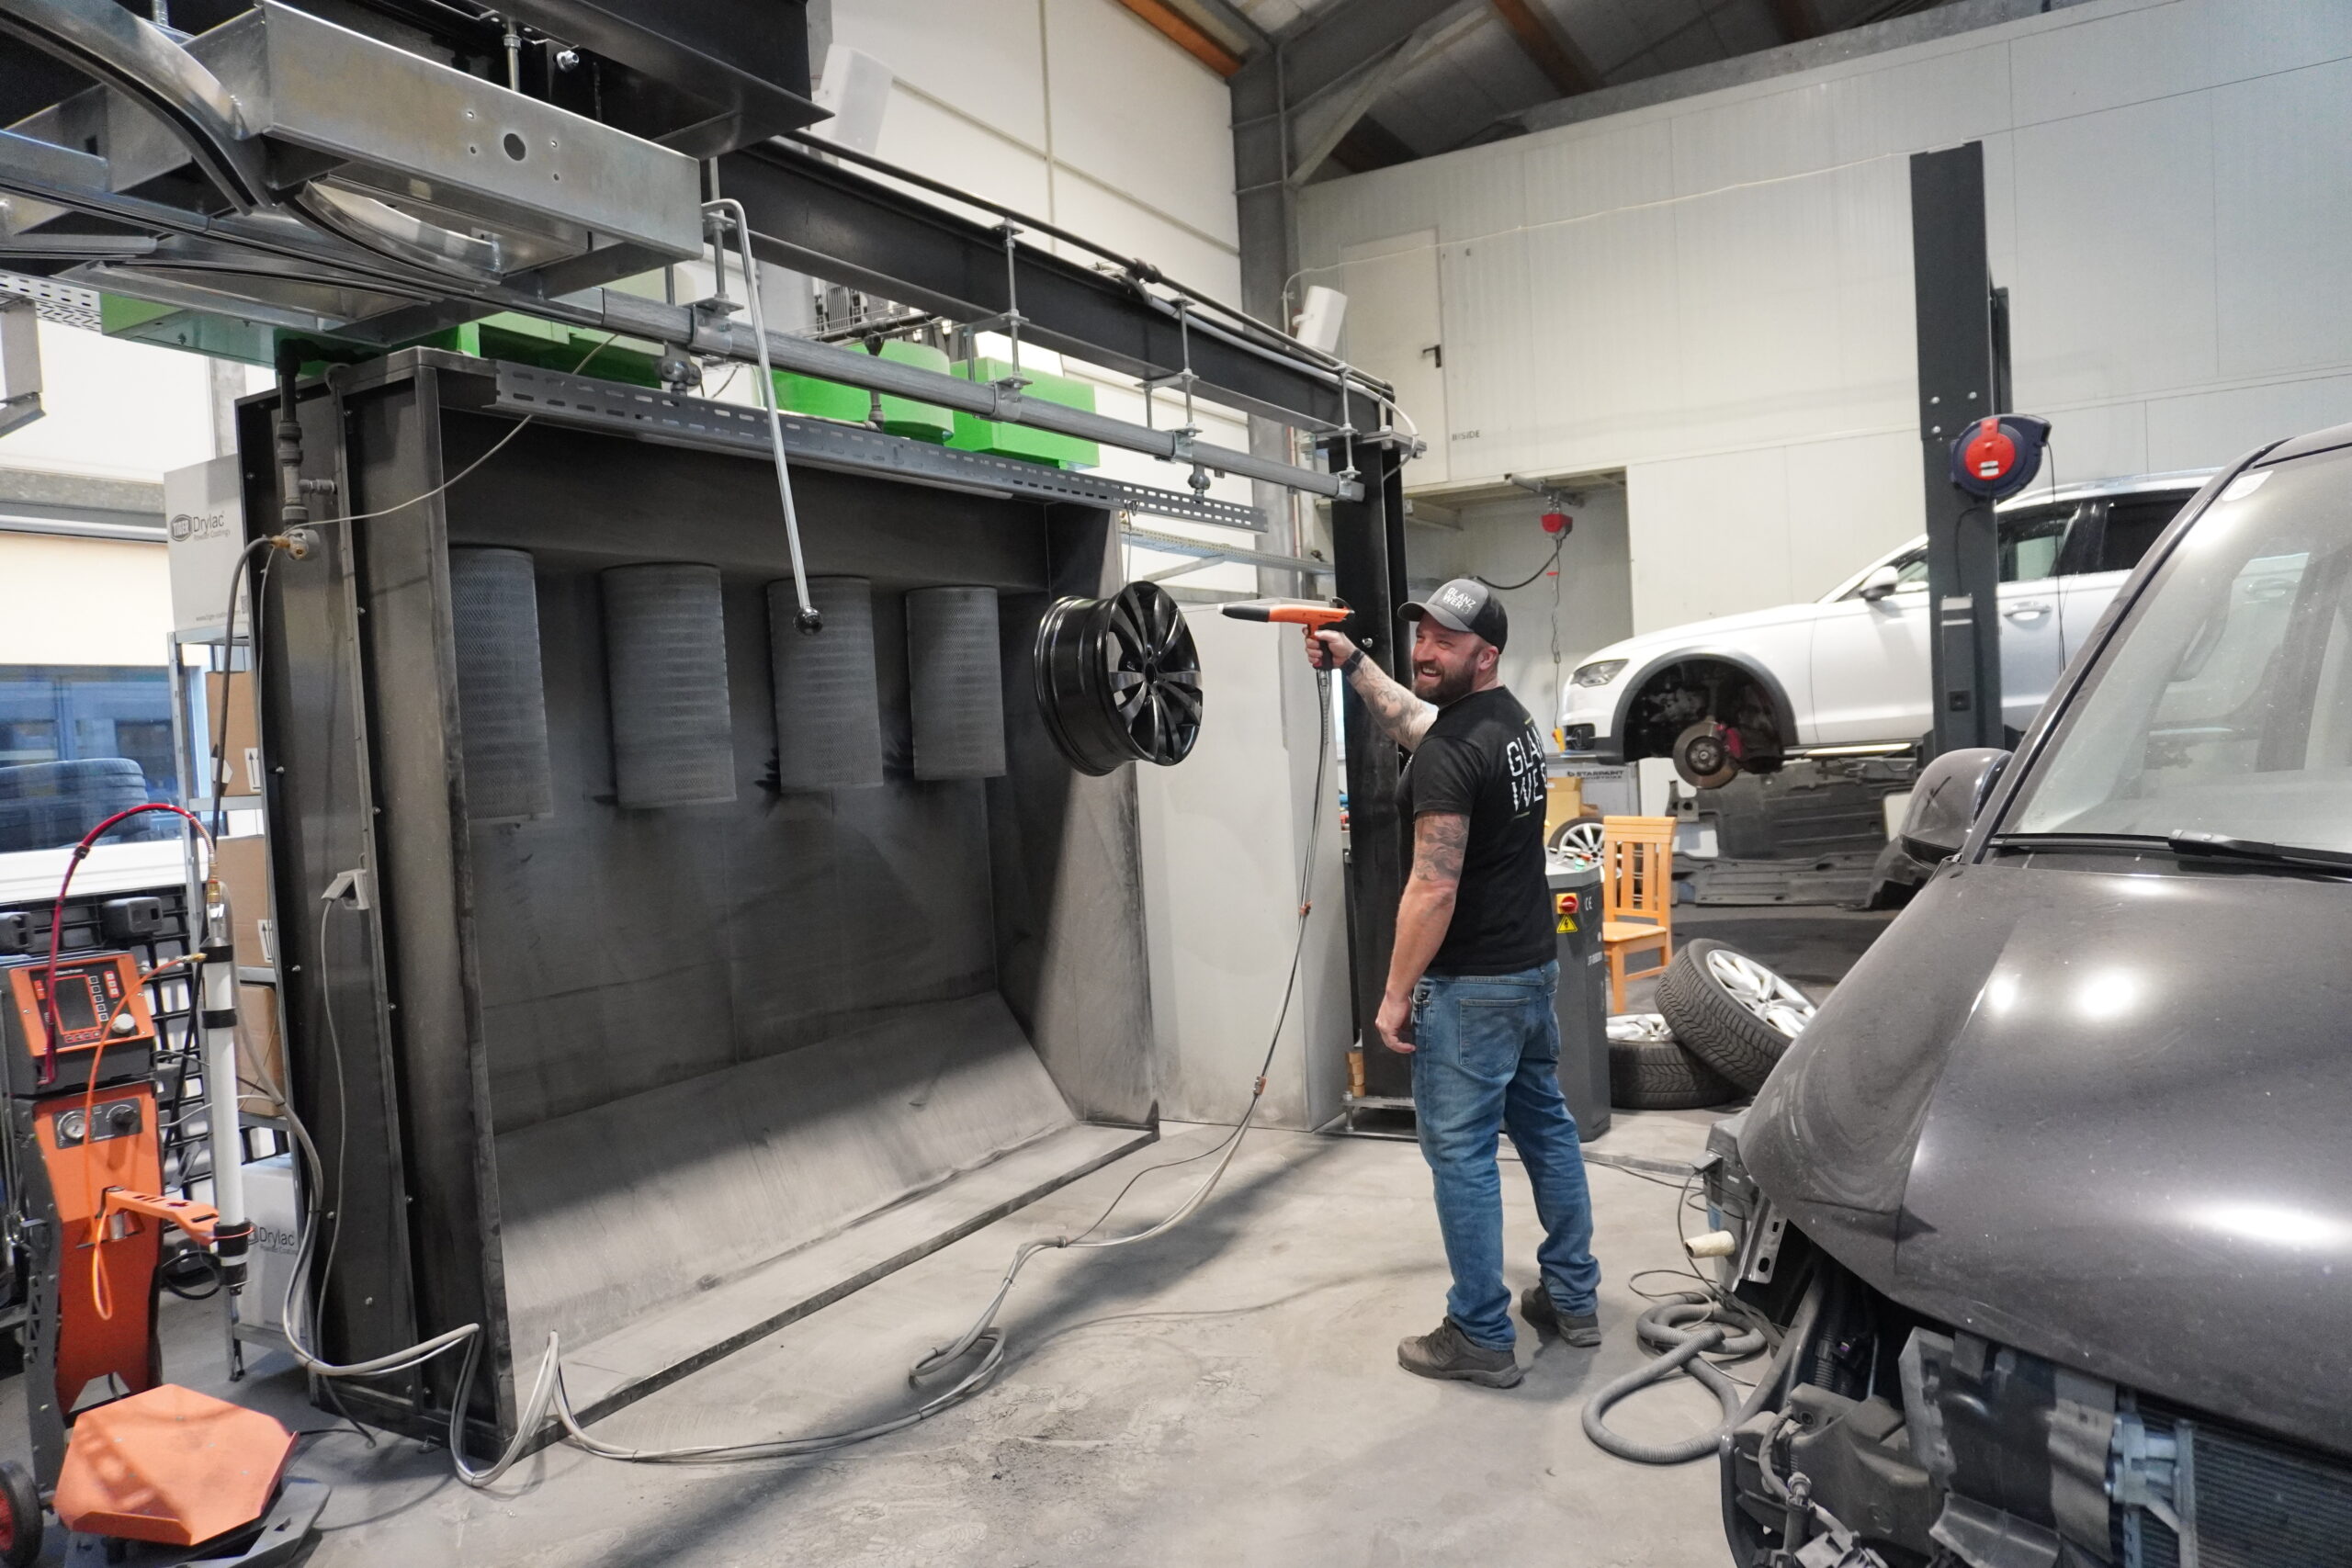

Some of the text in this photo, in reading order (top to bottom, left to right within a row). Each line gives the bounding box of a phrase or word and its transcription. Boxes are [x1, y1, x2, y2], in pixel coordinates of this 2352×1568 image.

[194, 513, 225, 536] Drylac
[1447, 587, 1476, 609] GLANZ
[259, 1227, 295, 1248] Drylac
